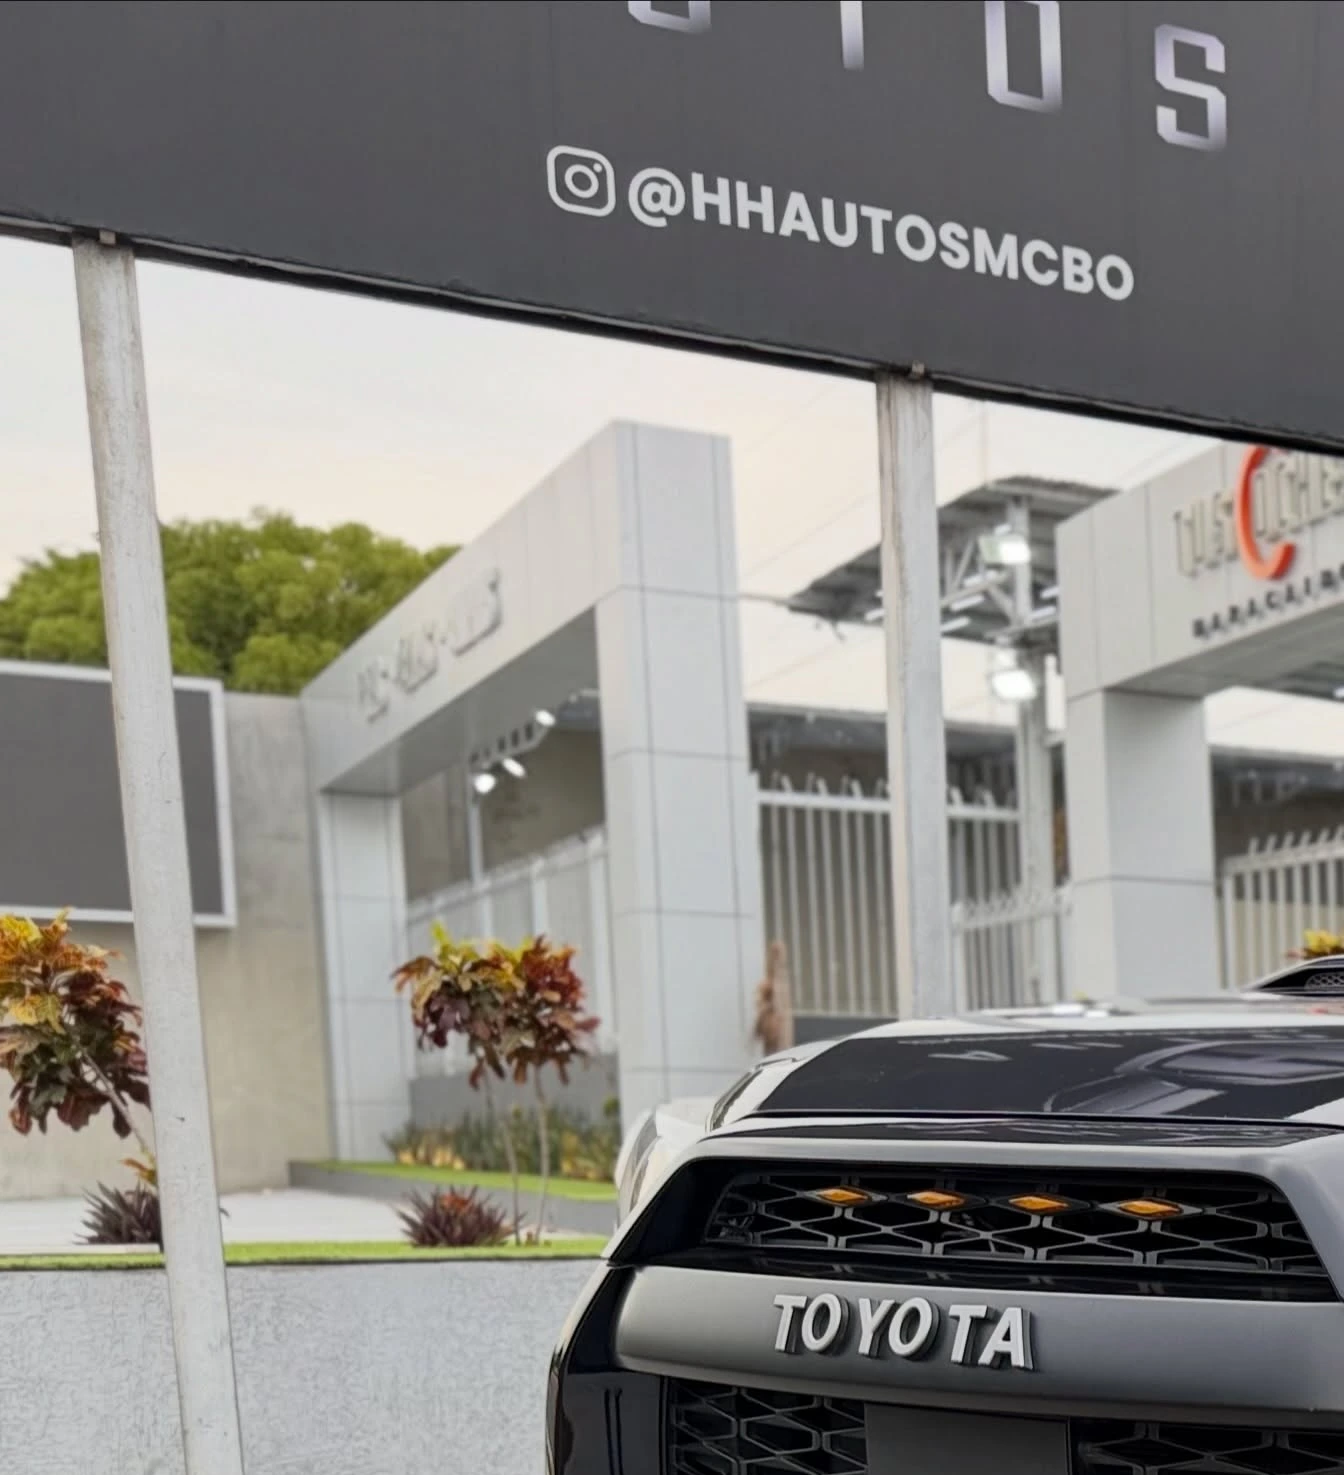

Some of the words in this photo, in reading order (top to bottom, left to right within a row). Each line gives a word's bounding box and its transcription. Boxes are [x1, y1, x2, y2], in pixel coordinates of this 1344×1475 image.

[628, 0, 1227, 152] OS
[627, 166, 1135, 302] @HHAUTOSMCBO
[773, 1292, 1035, 1371] TOYOTA
